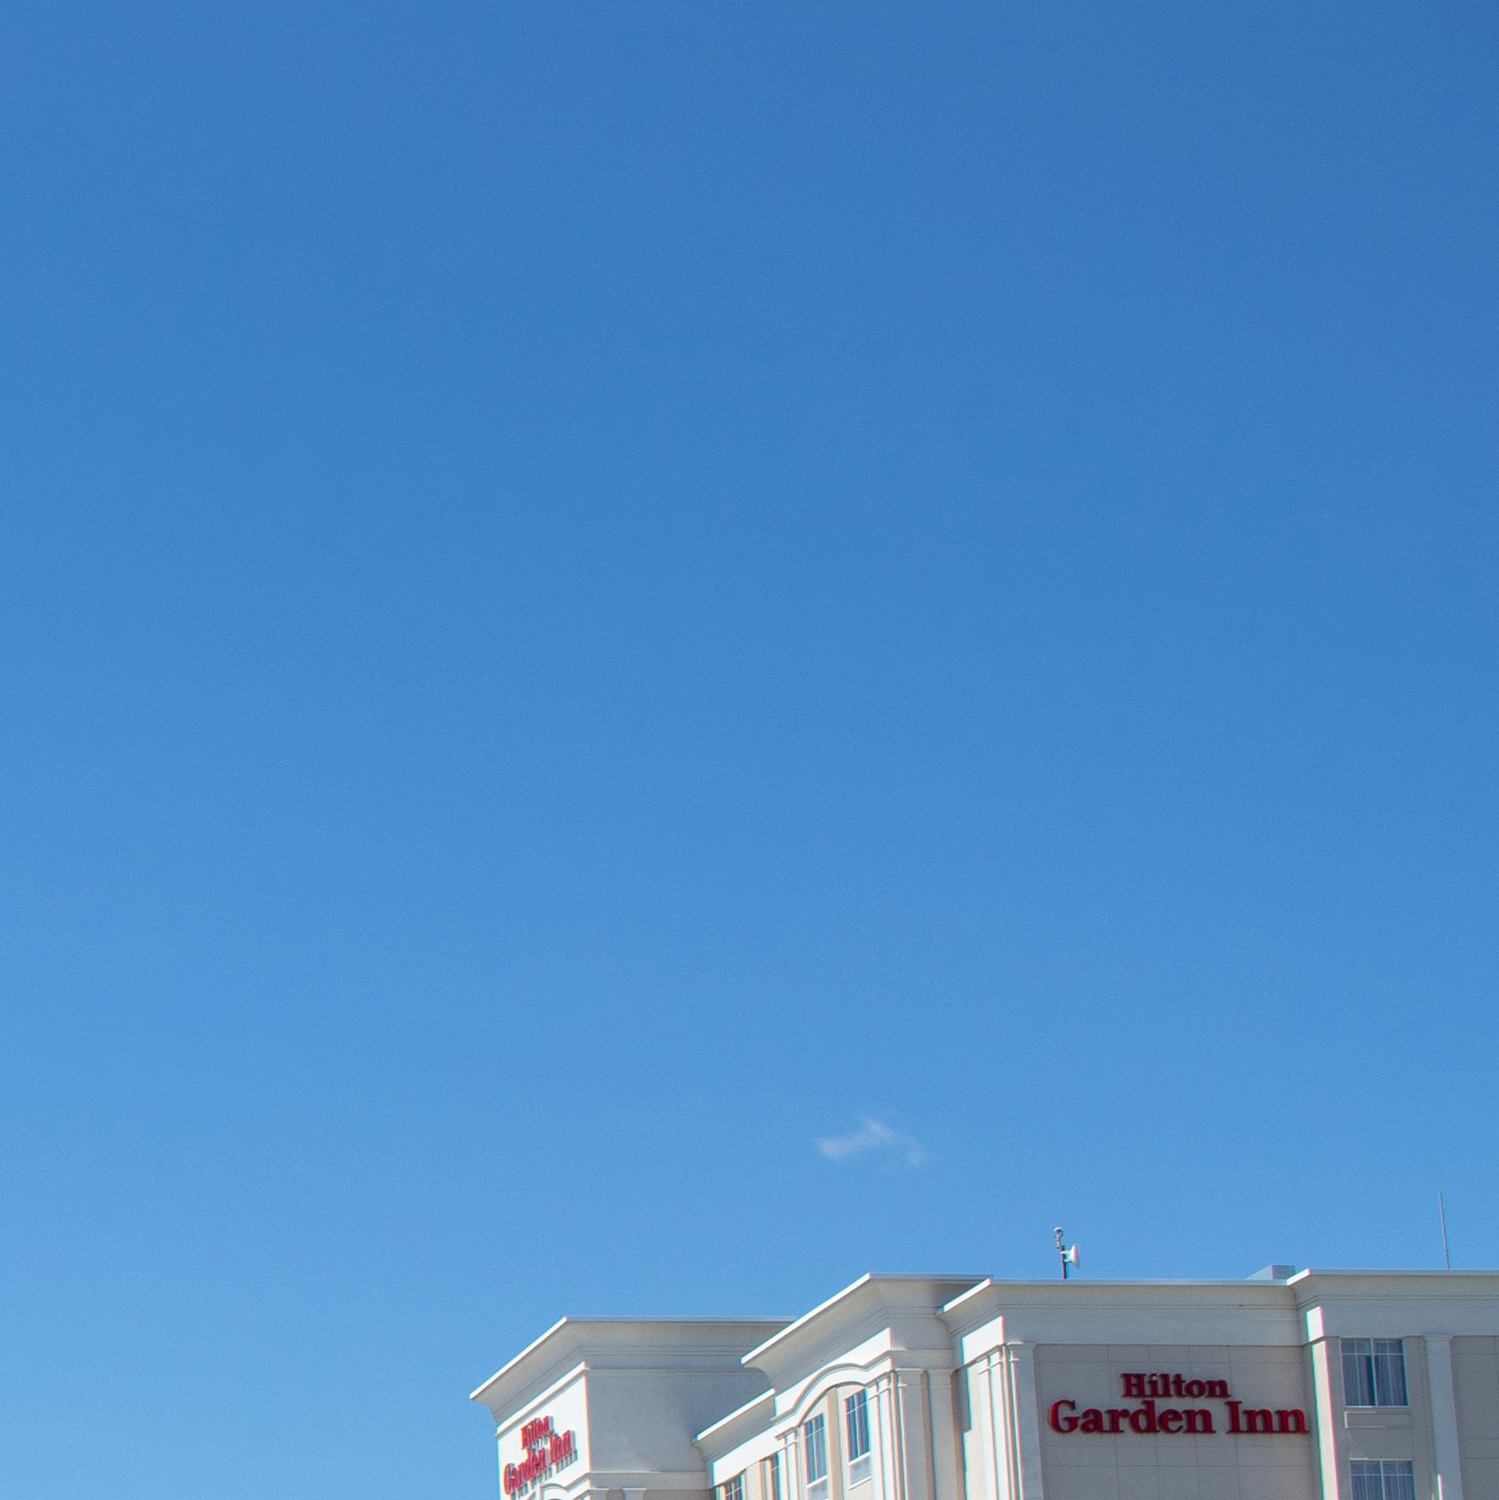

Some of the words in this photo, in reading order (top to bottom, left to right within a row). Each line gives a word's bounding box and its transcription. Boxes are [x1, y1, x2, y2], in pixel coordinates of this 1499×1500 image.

[1121, 1373, 1231, 1398] Hilton
[1049, 1400, 1216, 1434] Garden
[1225, 1401, 1310, 1434] Inn
